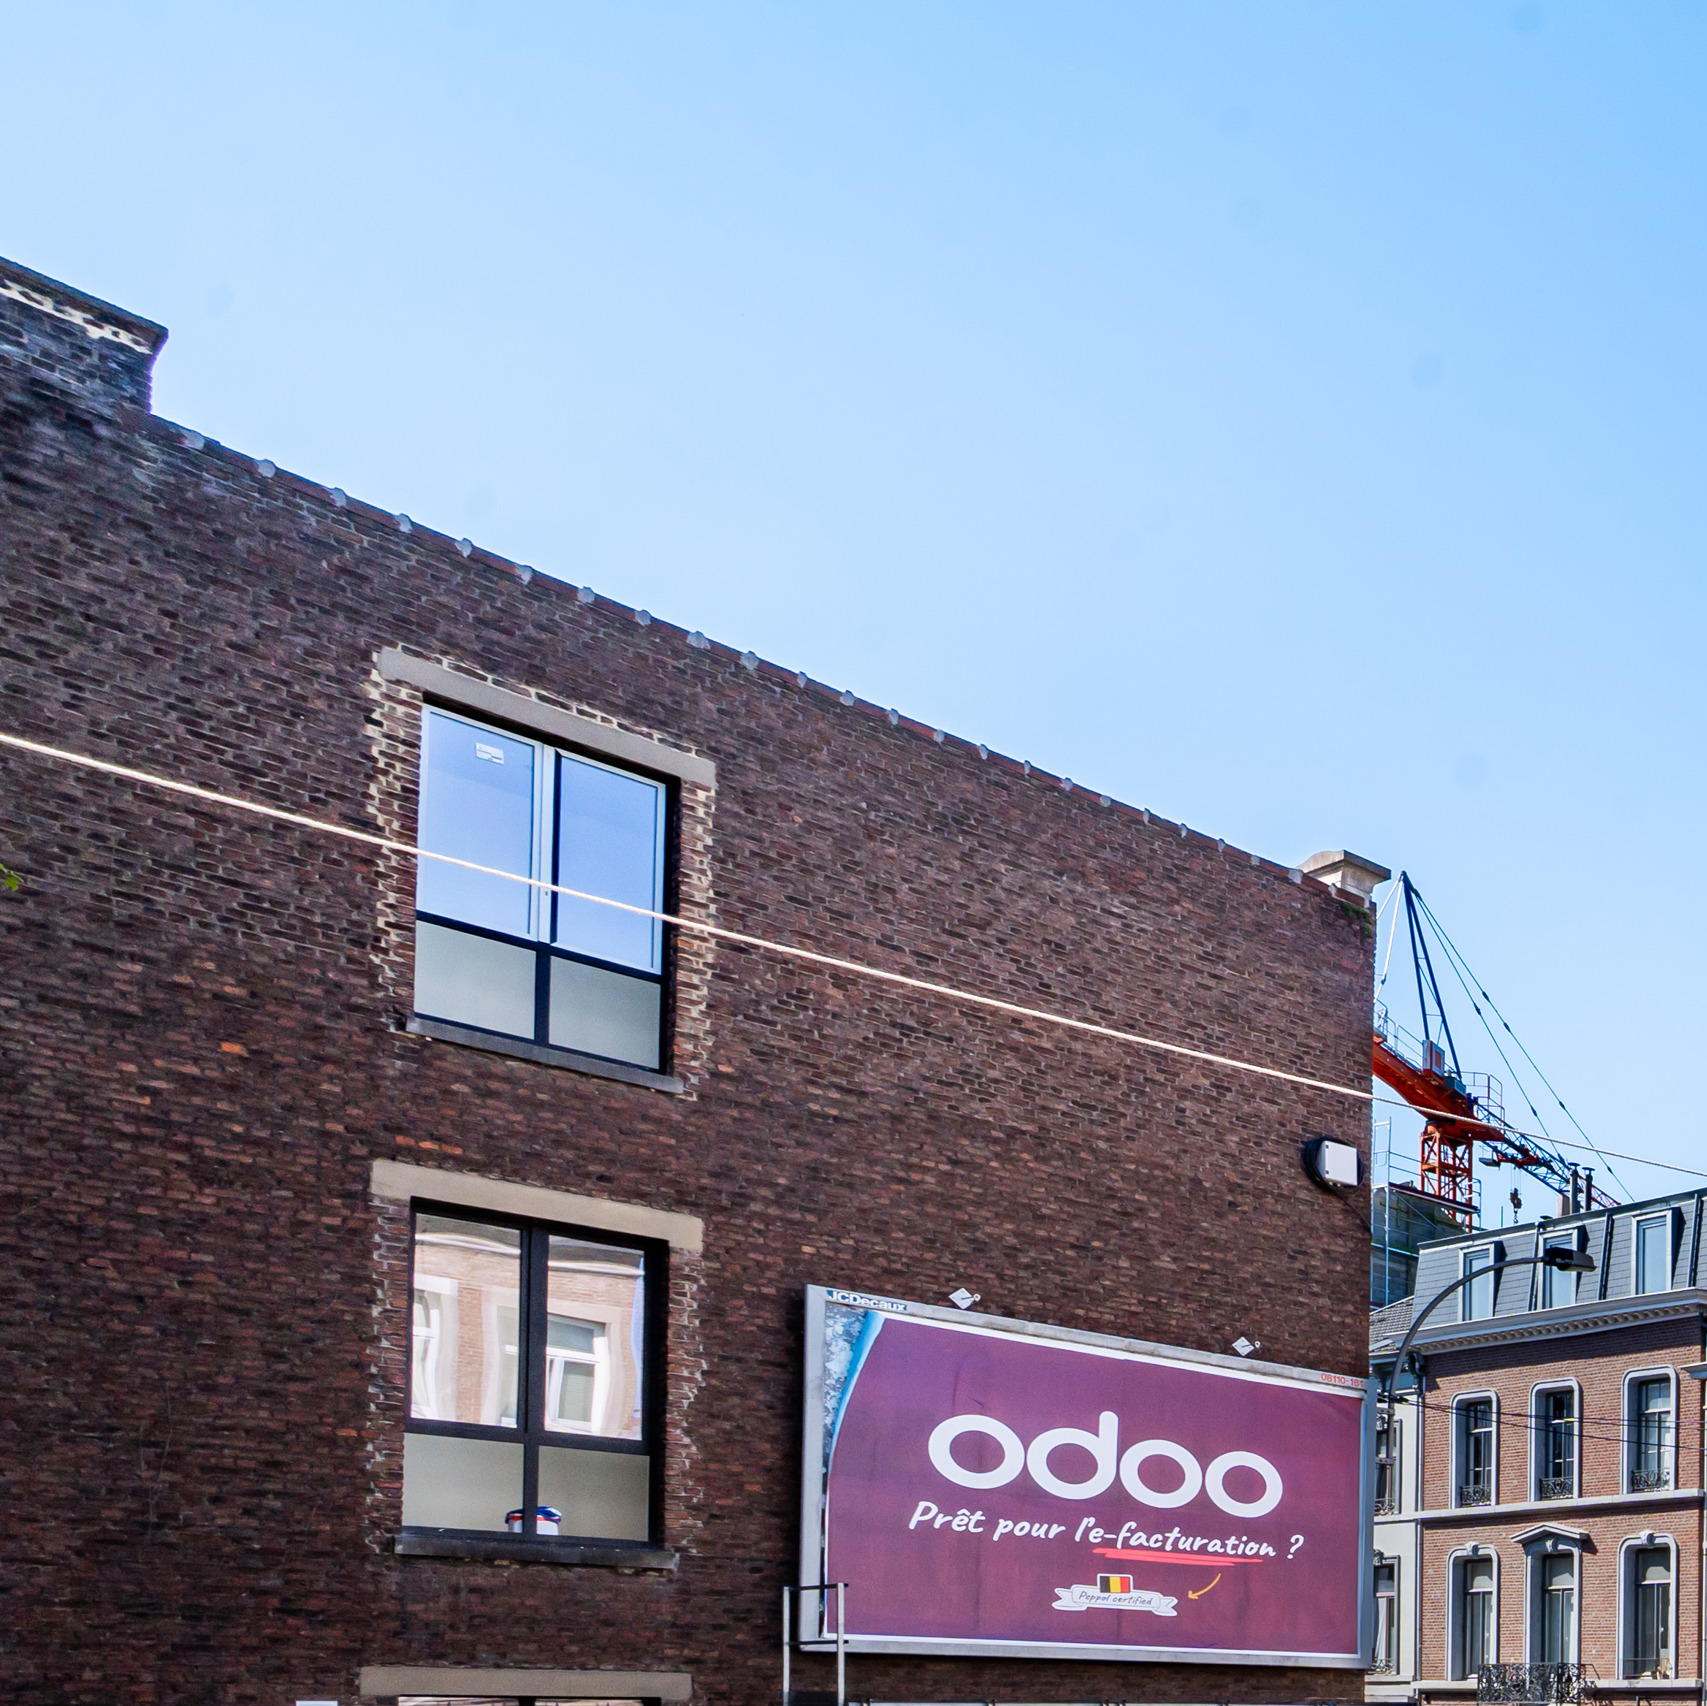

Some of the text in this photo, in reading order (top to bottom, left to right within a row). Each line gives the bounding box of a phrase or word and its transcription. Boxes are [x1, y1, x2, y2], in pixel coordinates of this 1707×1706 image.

[828, 1291, 907, 1312] JCDecaux
[928, 1411, 1283, 1518] odoo
[908, 1501, 986, 1533] Prêt
[992, 1519, 1066, 1542] pour
[1286, 1534, 1305, 1560] ?
[1078, 1590, 1154, 1606] Peppol certified
